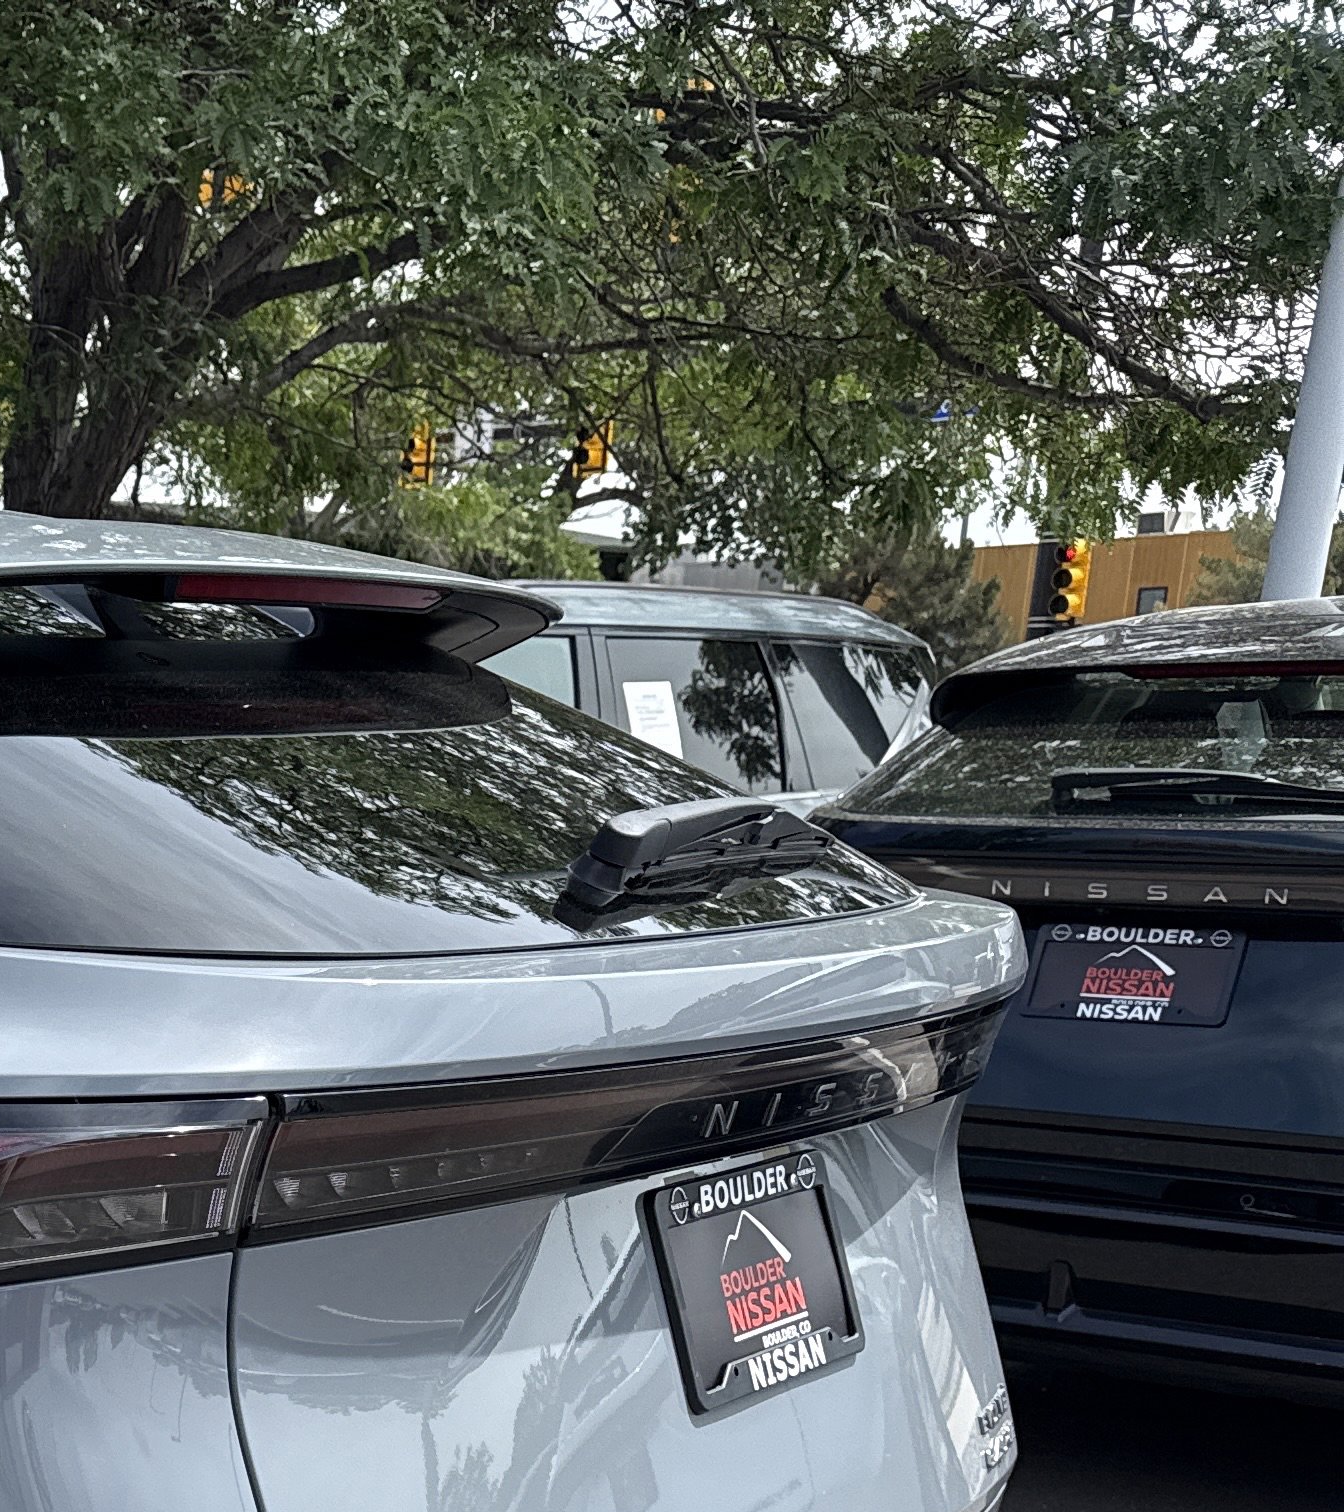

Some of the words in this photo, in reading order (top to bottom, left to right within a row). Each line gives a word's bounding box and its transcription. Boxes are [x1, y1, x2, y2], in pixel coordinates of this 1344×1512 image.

[991, 879, 1289, 905] NISSAN
[1086, 925, 1195, 945] BOULDER
[1085, 966, 1164, 981] BOULDER
[1081, 978, 1175, 998] NISSAN
[1076, 1002, 1163, 1022] NISSAN
[699, 1164, 789, 1214] BOULDER
[719, 1256, 787, 1298] BOULDER
[726, 1276, 808, 1335] NISSAN
[747, 1333, 828, 1391] NISSAN
